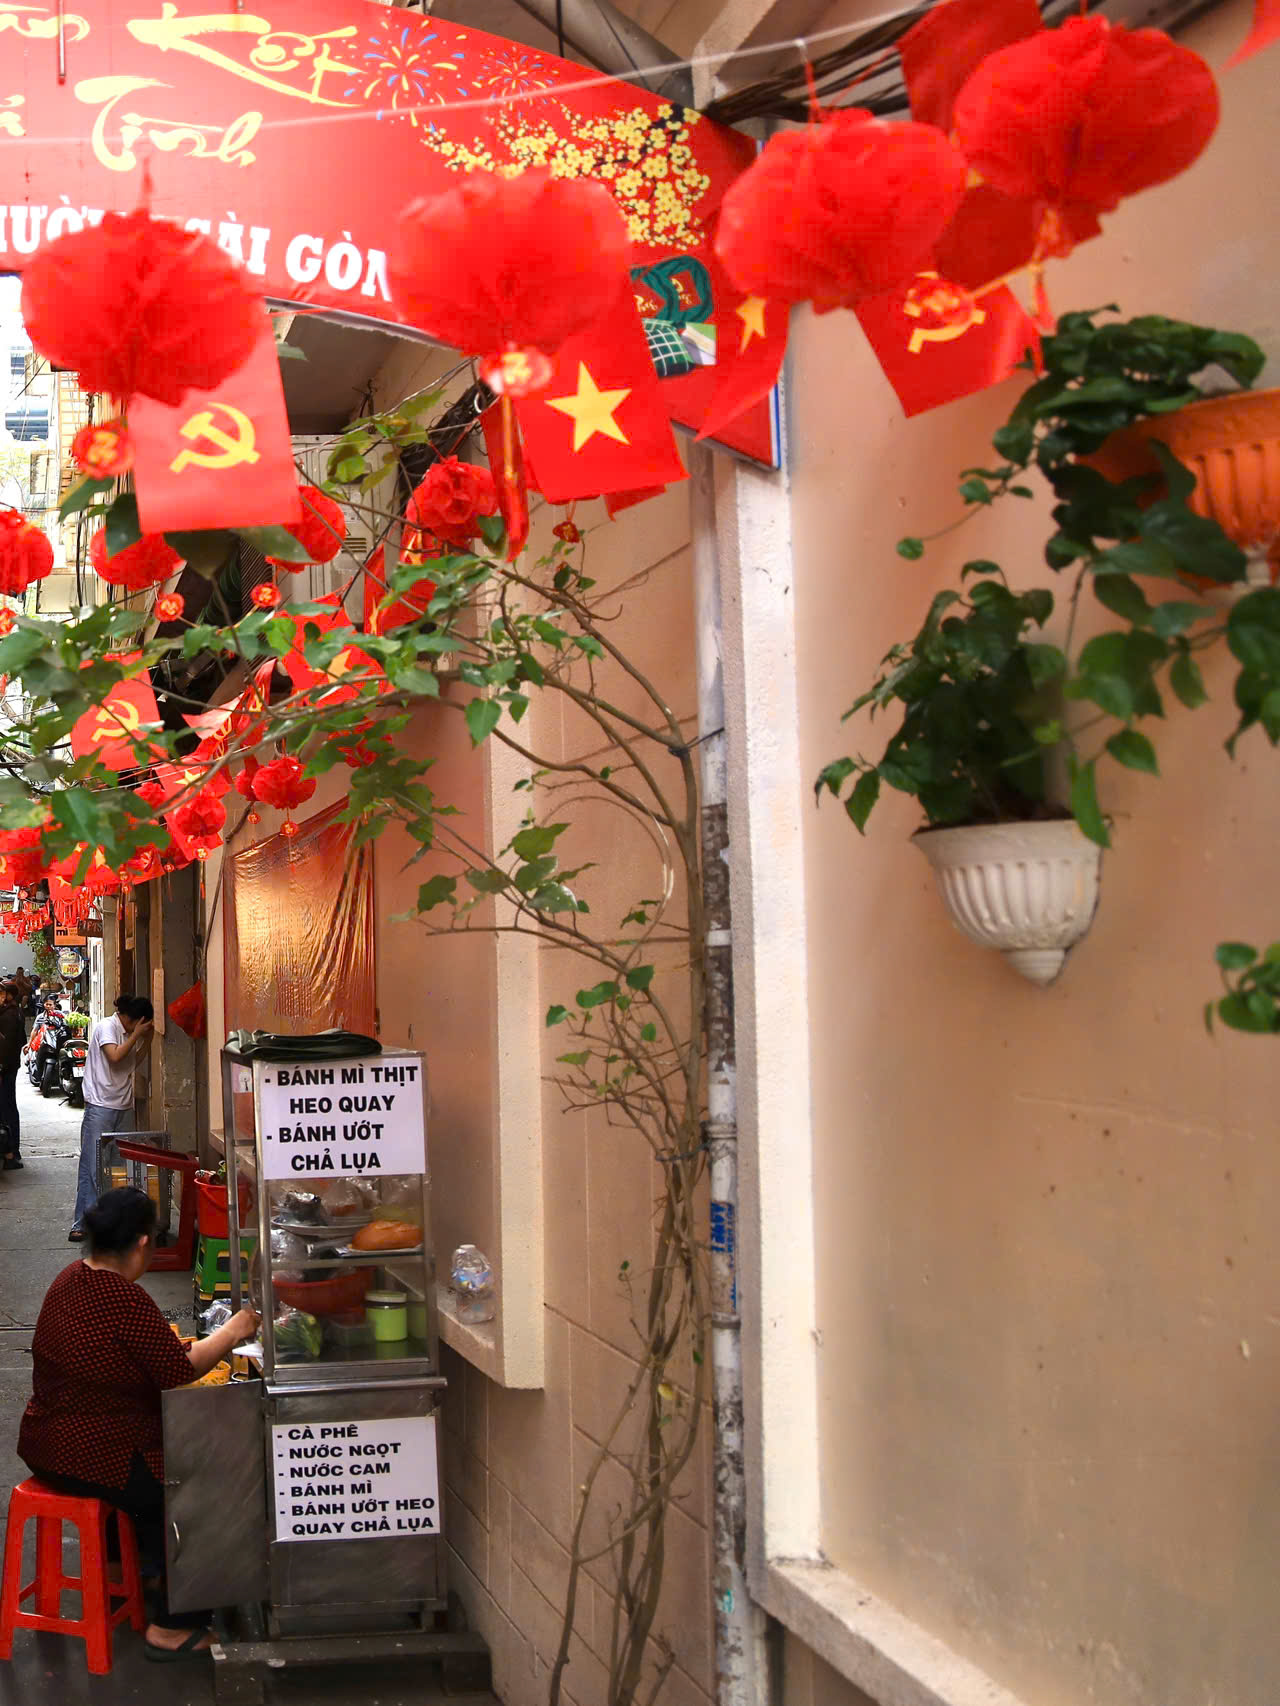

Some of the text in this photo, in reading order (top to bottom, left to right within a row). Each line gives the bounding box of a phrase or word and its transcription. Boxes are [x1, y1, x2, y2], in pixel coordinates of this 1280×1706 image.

[127, 2, 367, 108] Kết
[74, 76, 263, 171] Tình
[277, 1066, 335, 1086] BÁNH
[341, 1064, 364, 1084] MÌ
[371, 1066, 418, 1087] THỊT
[290, 1095, 395, 1114] HEO QUAY
[279, 1122, 336, 1143] BÁNH
[343, 1120, 384, 1140] ƯỚT
[291, 1148, 381, 1174] CHẢ LỤA
[288, 1426, 314, 1441] CÀ
[320, 1424, 359, 1439] PHÊ
[289, 1444, 343, 1459] NƯỚC
[349, 1442, 401, 1458] NGỌT
[290, 1463, 344, 1478] NƯỚC
[349, 1462, 391, 1476] CAM
[291, 1483, 344, 1497] BÁNH
[351, 1480, 372, 1495] MÌ
[291, 1502, 345, 1517] BÁNH
[352, 1499, 389, 1514] ƯỚT
[395, 1498, 435, 1511] HEO
[292, 1516, 434, 1537] QUAY CHẢ LỤA
